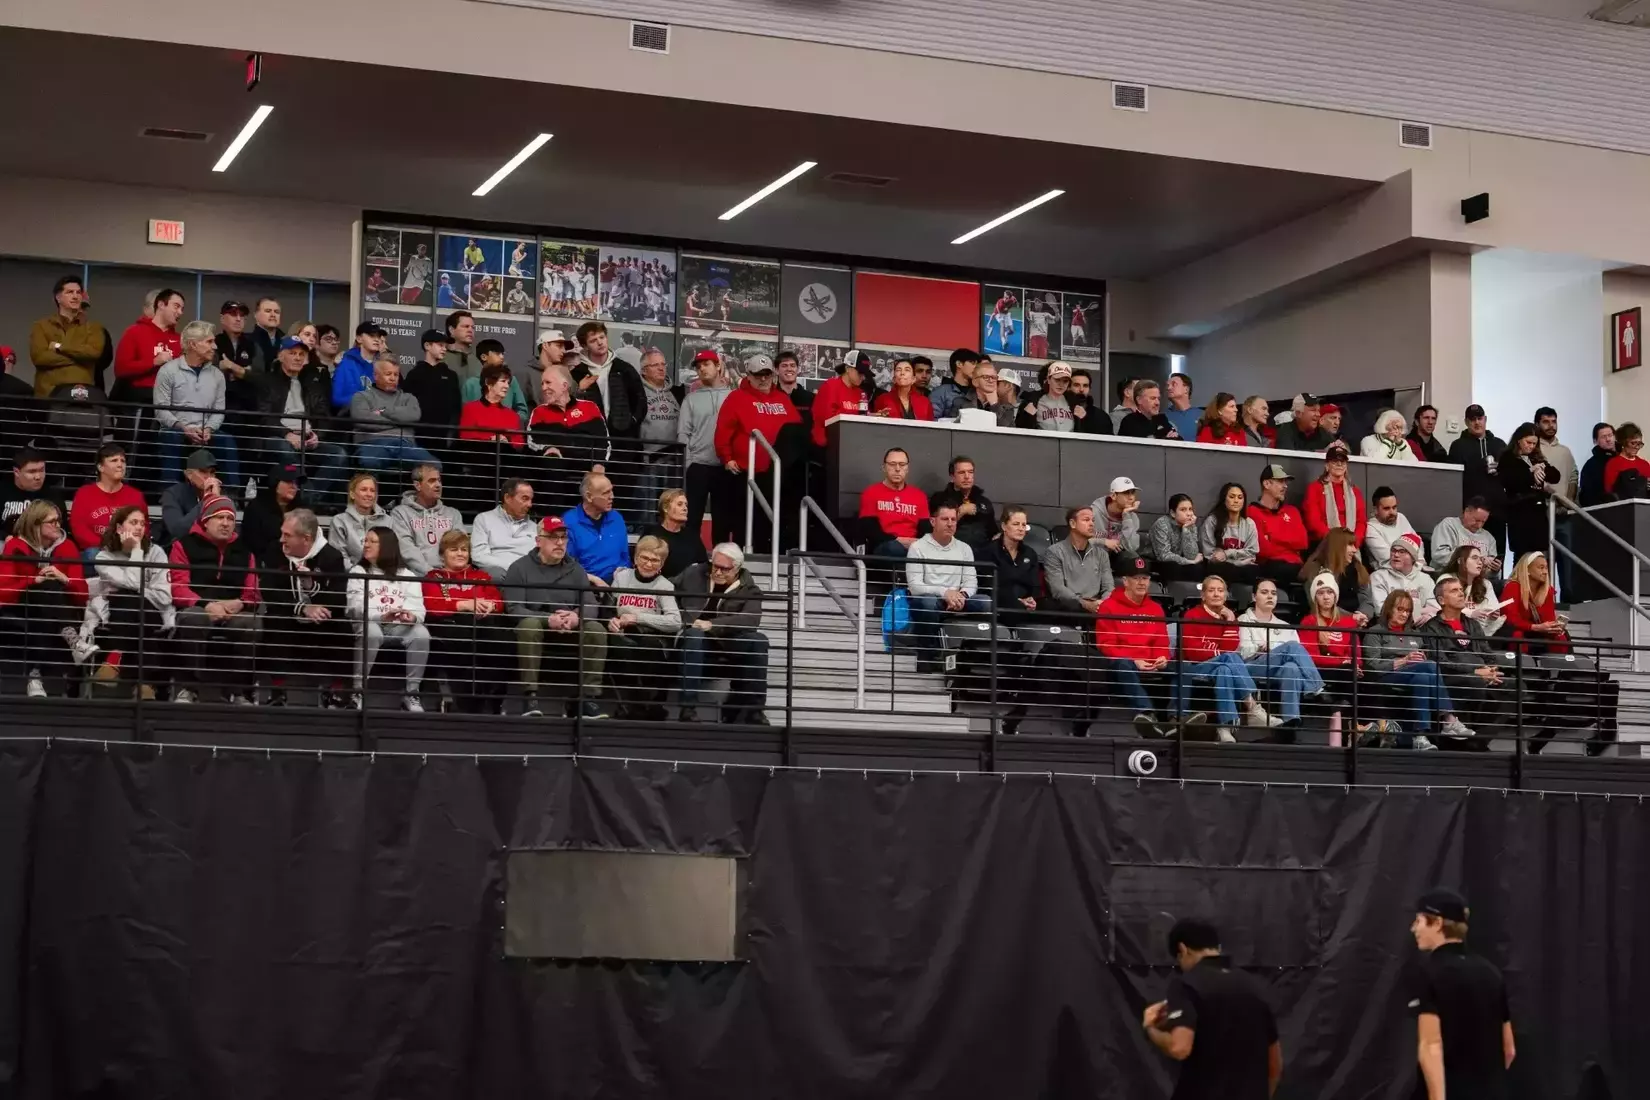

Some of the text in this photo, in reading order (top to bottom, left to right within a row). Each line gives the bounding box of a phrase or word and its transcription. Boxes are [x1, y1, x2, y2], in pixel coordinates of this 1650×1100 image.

[156, 222, 179, 240] EXIT
[389, 319, 423, 328] NATIONALLY
[398, 329, 416, 337] YEARS
[490, 326, 501, 334] THE
[501, 327, 517, 335] PROS
[399, 355, 416, 366] 2020
[1059, 407, 1075, 420] STAT
[2, 501, 23, 521] OHIO
[877, 500, 917, 516] OHIO STATE
[619, 595, 658, 609] BUCKEYES
